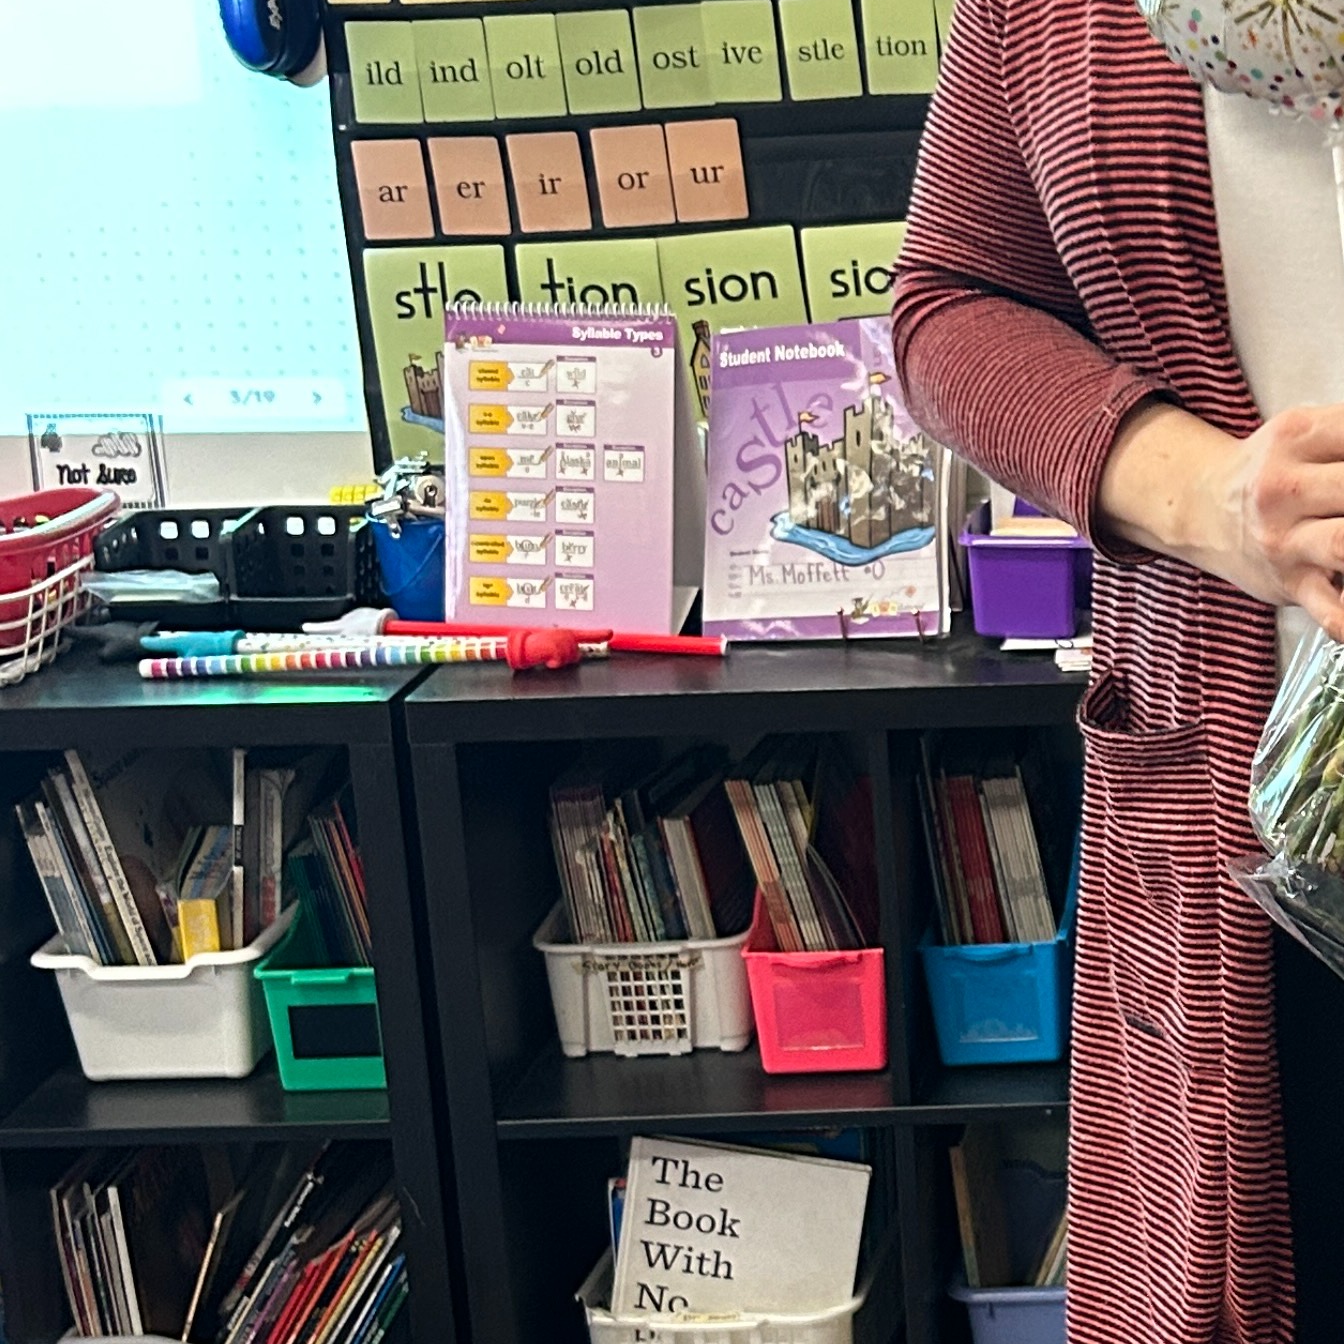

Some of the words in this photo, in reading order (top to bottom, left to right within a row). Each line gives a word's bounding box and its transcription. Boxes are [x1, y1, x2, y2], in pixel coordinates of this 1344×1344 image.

[366, 60, 403, 86] ild
[430, 58, 479, 83] ind
[506, 54, 544, 80] olt
[575, 49, 624, 76] old
[652, 46, 699, 70] ost
[722, 41, 762, 64] ive
[798, 38, 844, 62] stle
[876, 36, 927, 57] tion
[378, 185, 408, 203] ar
[456, 181, 486, 199] er
[538, 177, 562, 195] ir
[617, 171, 649, 190] or
[689, 165, 724, 184] ur
[683, 268, 778, 306] sion
[830, 259, 894, 298] sio
[572, 327, 621, 341] Syllable
[625, 328, 664, 342] Types
[720, 348, 771, 368] Student
[775, 341, 845, 361] Notebook
[651, 1157, 725, 1192] The
[644, 1198, 741, 1239] Book
[640, 1241, 734, 1280] With
[634, 1283, 688, 1312] No
